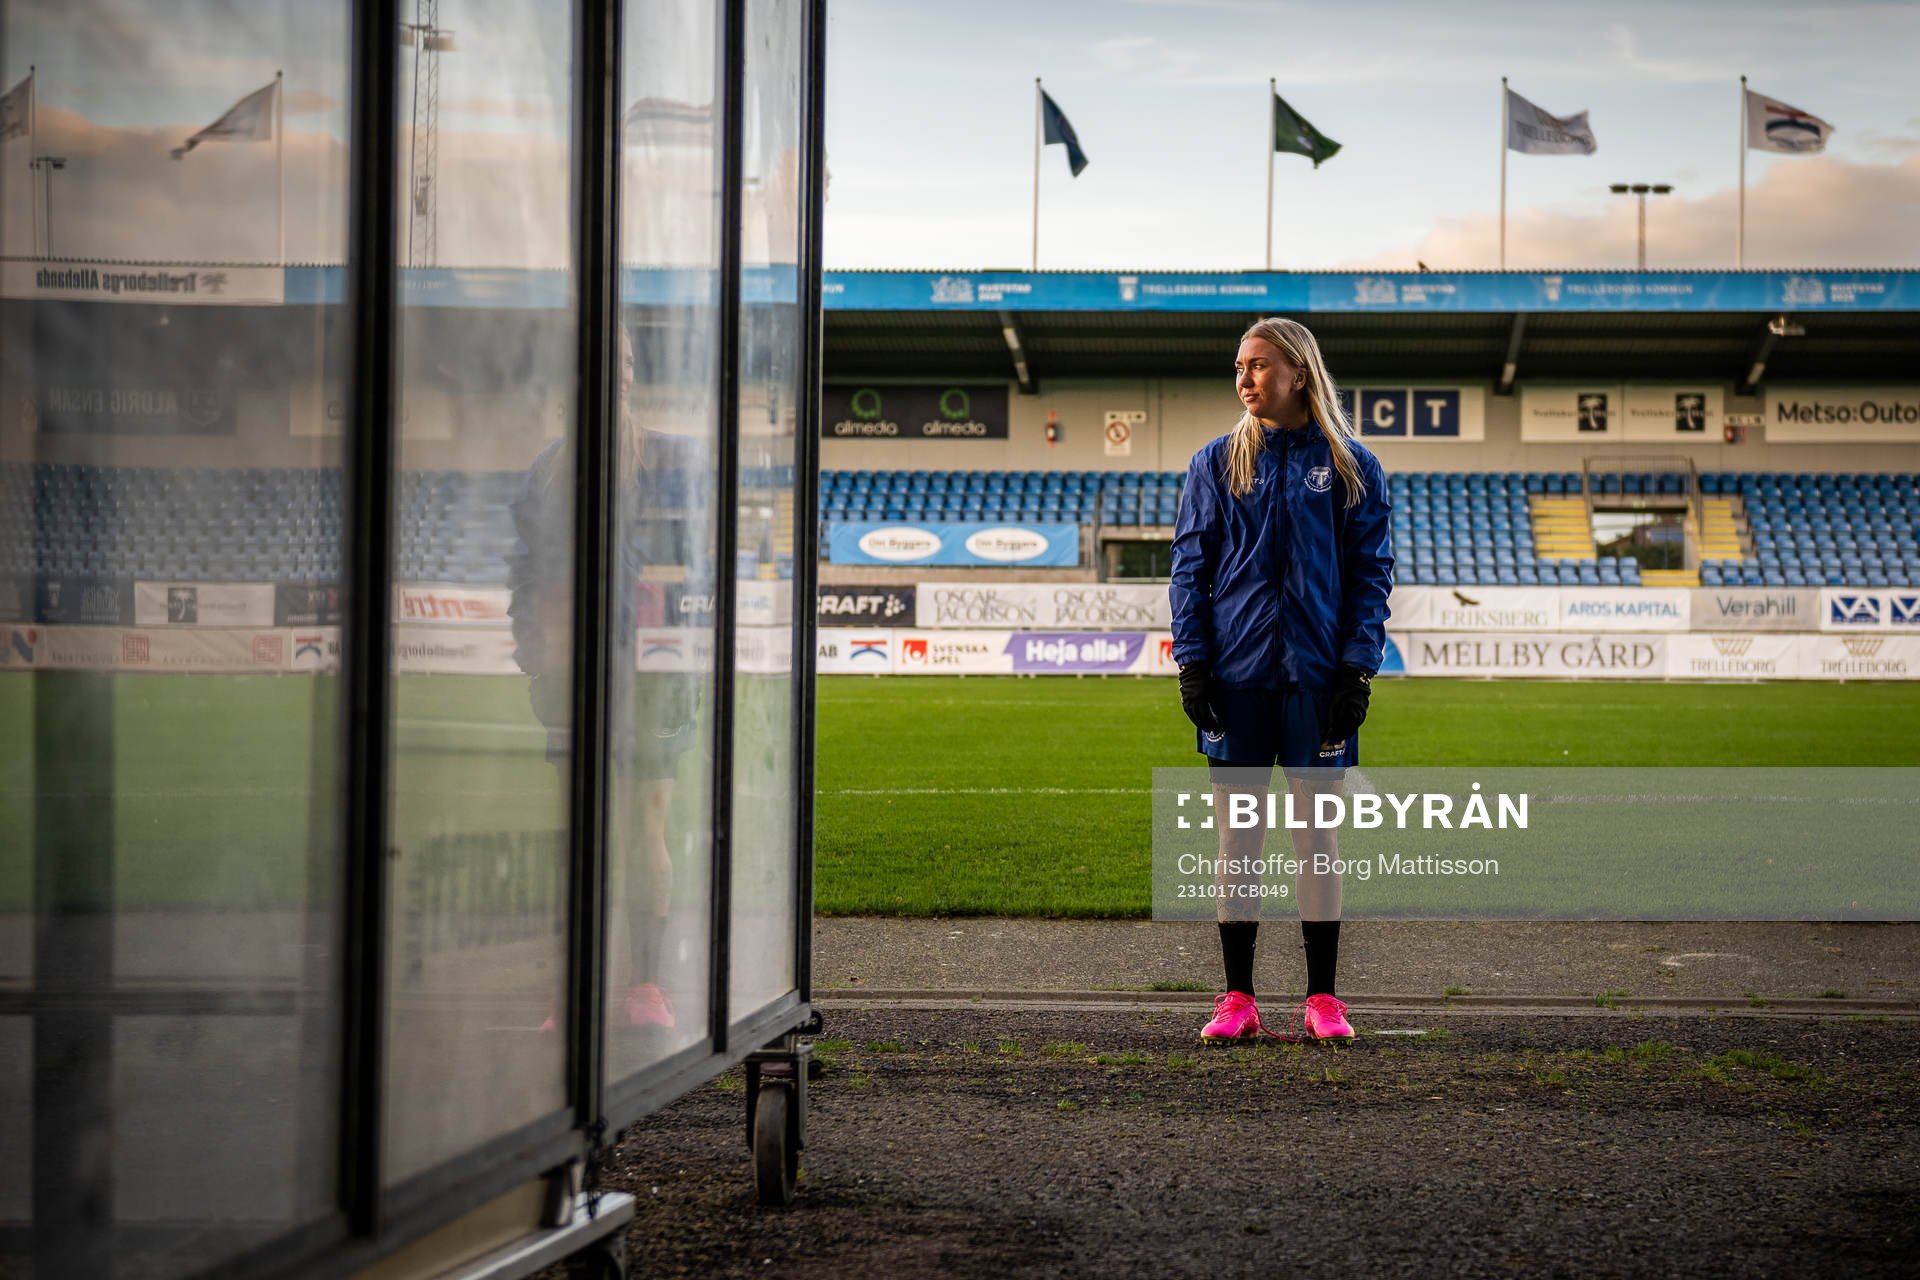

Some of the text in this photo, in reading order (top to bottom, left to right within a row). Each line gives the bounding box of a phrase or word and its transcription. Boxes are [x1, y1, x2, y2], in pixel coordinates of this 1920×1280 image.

[1778, 401, 1920, 424] Metso:Outo
[934, 590, 997, 602] OSCAR
[1054, 590, 1117, 603] OSCAR
[936, 604, 1037, 623] JACOBSON
[1056, 604, 1156, 623] JACOBSON
[1568, 602, 1680, 617] AROS KAPITAL
[1716, 595, 1796, 617] Verahill
[1441, 610, 1548, 627] ERIKSBERG
[818, 644, 837, 657] AB
[932, 644, 989, 653] SVENSKA
[1025, 638, 1127, 666] Heja alla!
[1423, 637, 1655, 668] MELLBY GÅRD
[932, 655, 960, 664] SPEL
[1690, 658, 1776, 673] TRELLEBORG
[1821, 658, 1907, 673] TRELLEBORG
[1319, 750, 1342, 758] CRAFT
